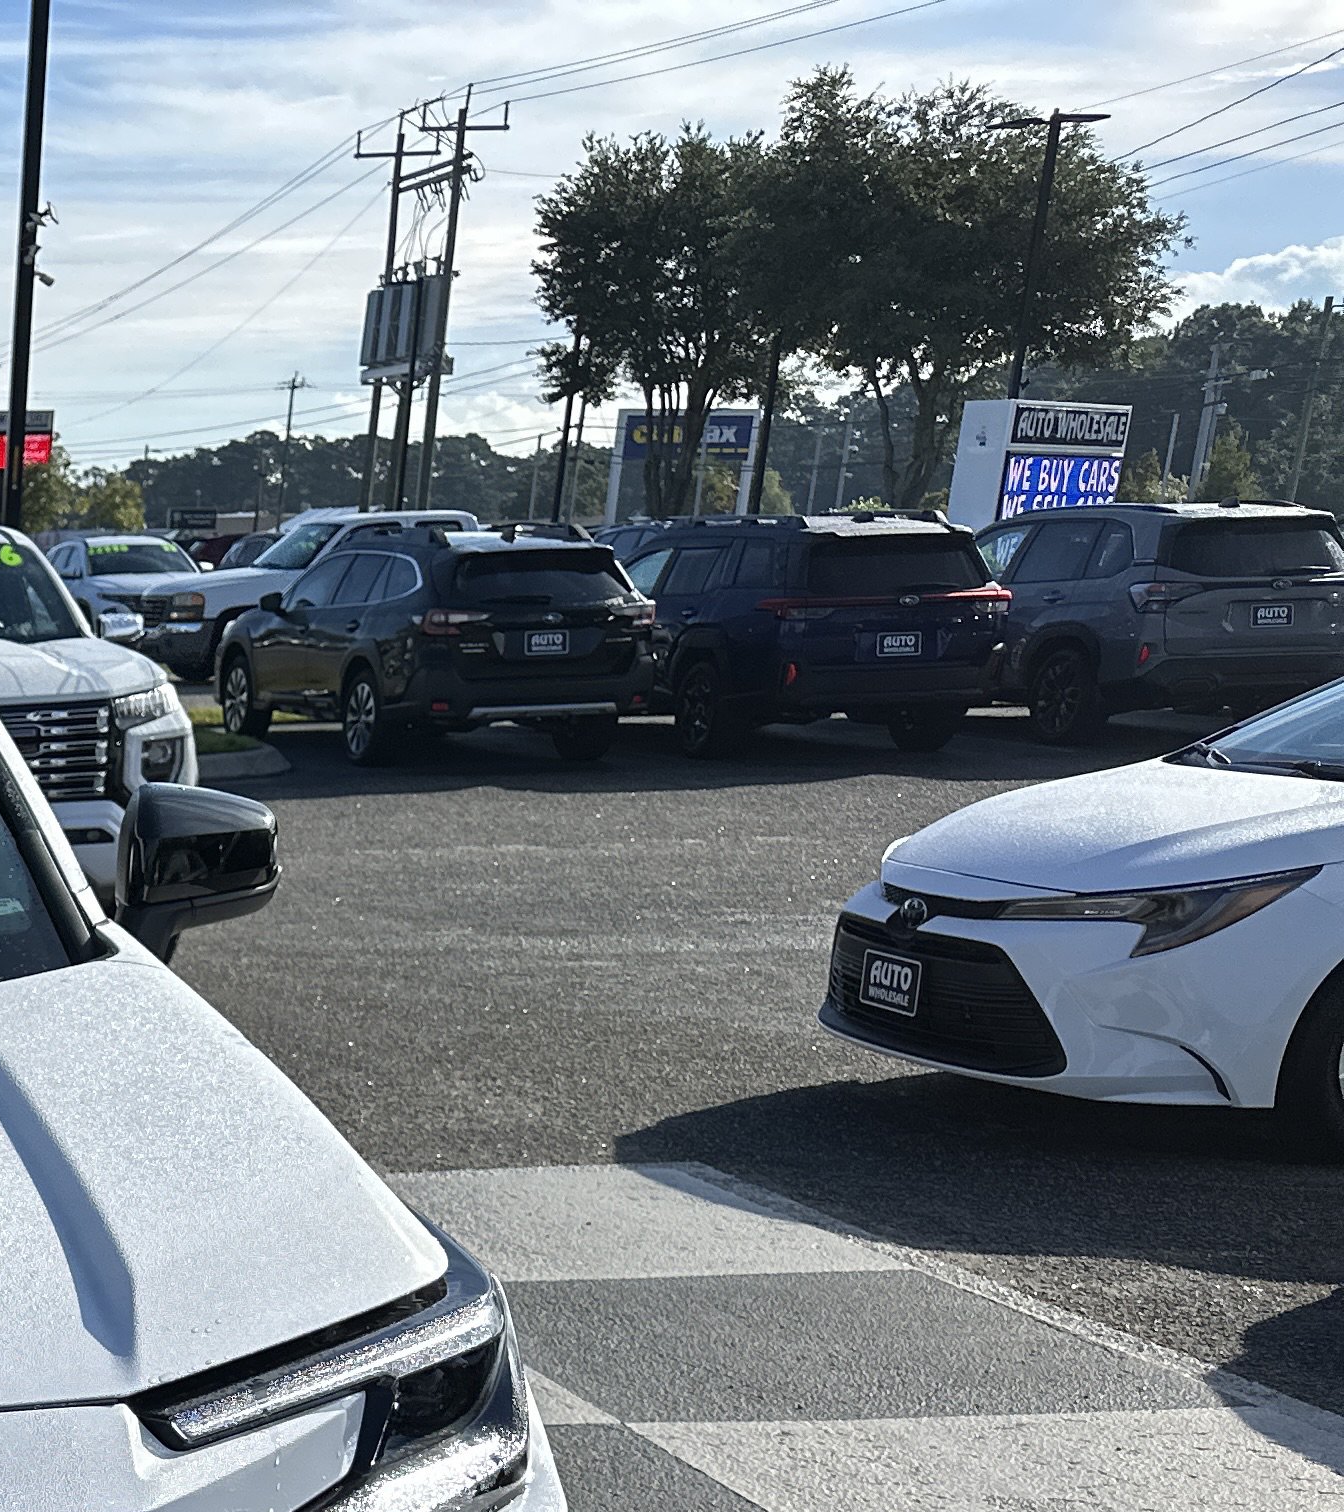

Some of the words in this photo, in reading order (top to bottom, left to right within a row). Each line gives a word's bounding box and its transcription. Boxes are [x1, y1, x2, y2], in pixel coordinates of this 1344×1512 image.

[1017, 409, 1055, 439] AUTO
[1055, 410, 1128, 443] WHOLESALE
[1007, 456, 1034, 492] WE
[1037, 458, 1075, 493] BUY
[1078, 459, 1121, 493] CARS
[1257, 607, 1288, 619] AUTO
[531, 633, 563, 646] AUTO
[883, 635, 915, 648] AUTO
[870, 960, 913, 992] AUTO
[868, 985, 910, 1007] WHOLESALE
